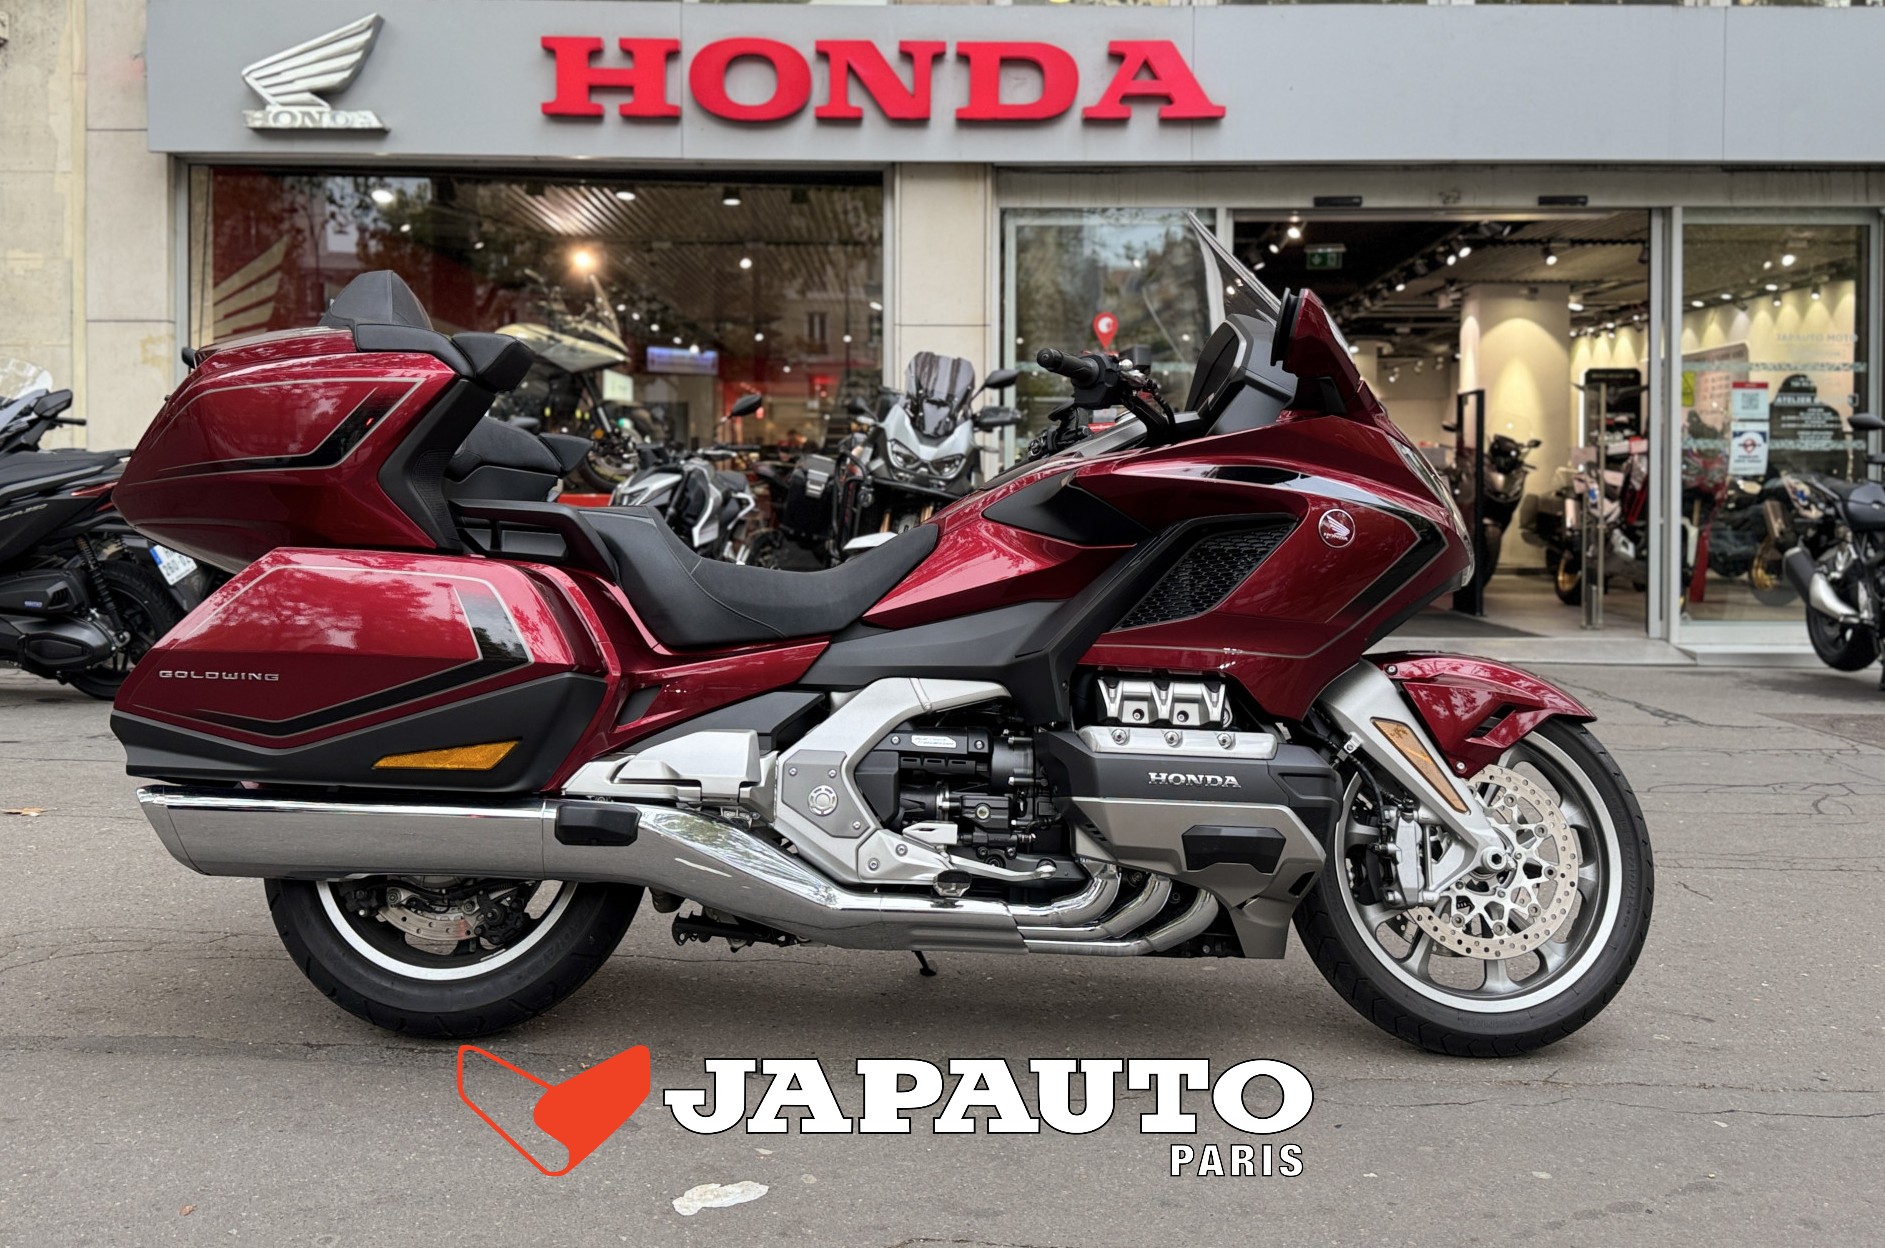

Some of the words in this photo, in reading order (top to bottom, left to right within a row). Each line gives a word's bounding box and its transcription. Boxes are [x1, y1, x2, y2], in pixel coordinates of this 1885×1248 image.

[540, 36, 1226, 122] HONDA
[243, 110, 386, 129] HONDA
[158, 670, 280, 681] GOLDWING
[1148, 772, 1242, 788] HONDA
